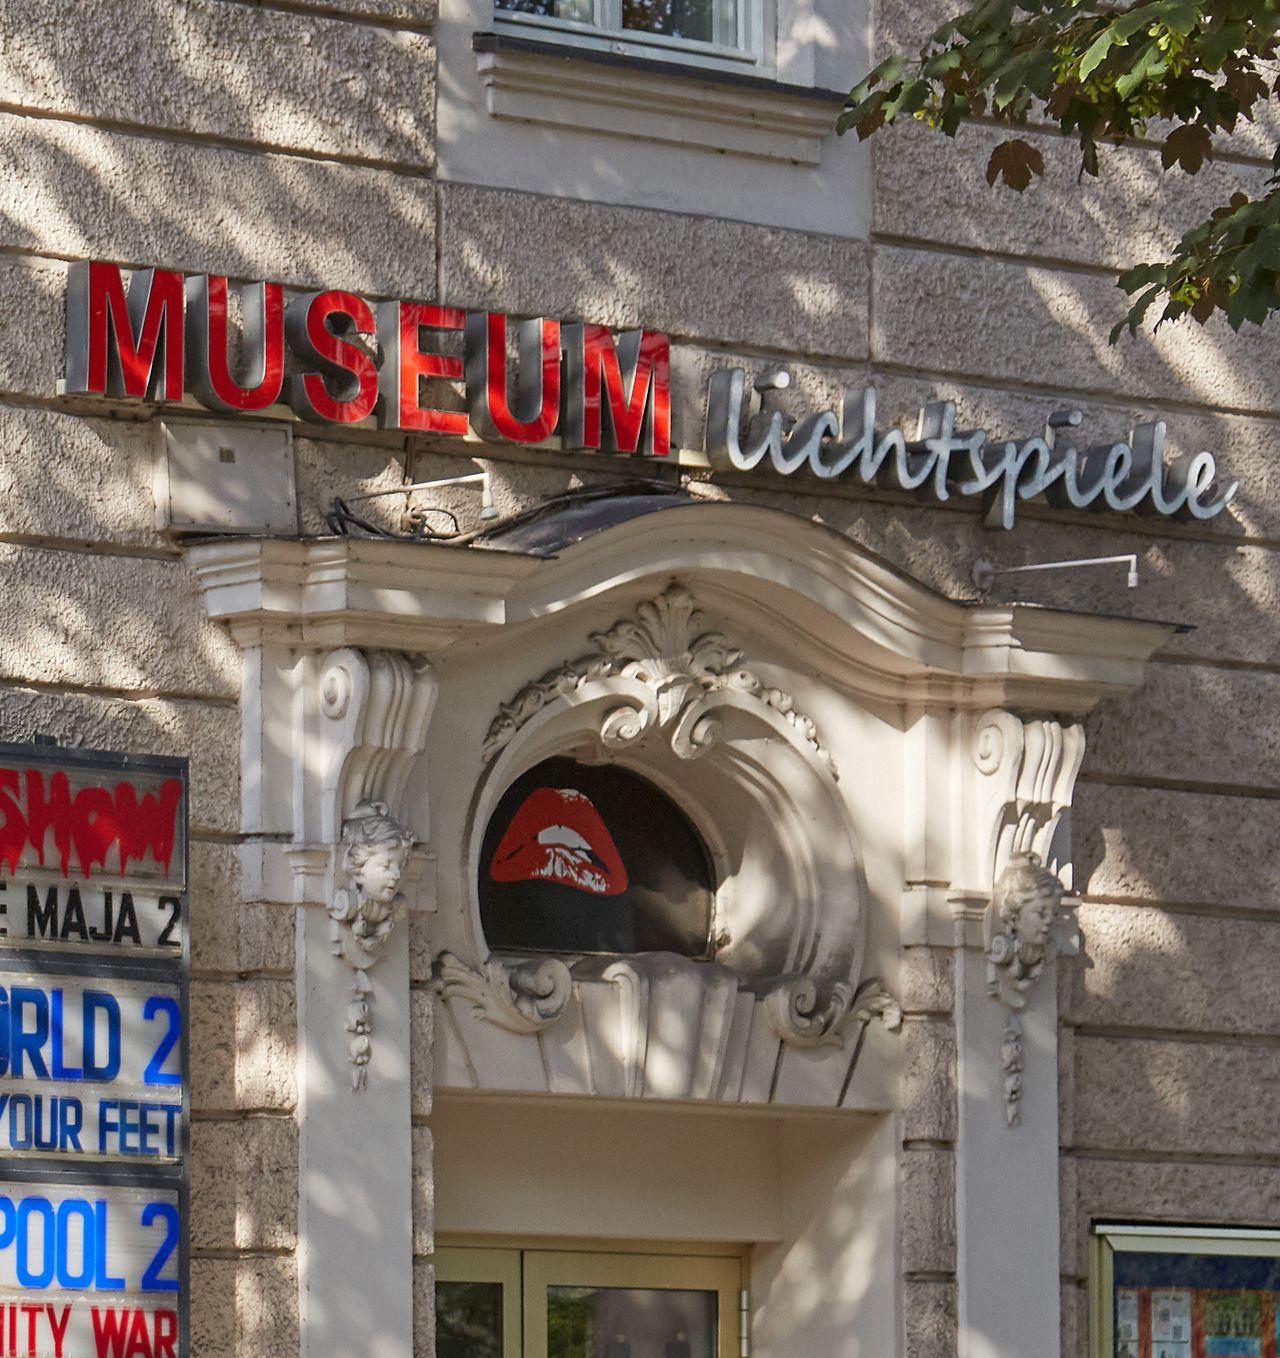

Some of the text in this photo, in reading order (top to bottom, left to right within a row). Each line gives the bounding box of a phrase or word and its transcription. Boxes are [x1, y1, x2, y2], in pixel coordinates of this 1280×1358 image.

[62, 258, 1240, 530] MUSEUM lichtspiele
[26, 884, 142, 946] MAJA
[157, 895, 183, 947] 2
[143, 995, 182, 1086] 2
[98, 1099, 183, 1156] FEET
[140, 1202, 181, 1293] 2
